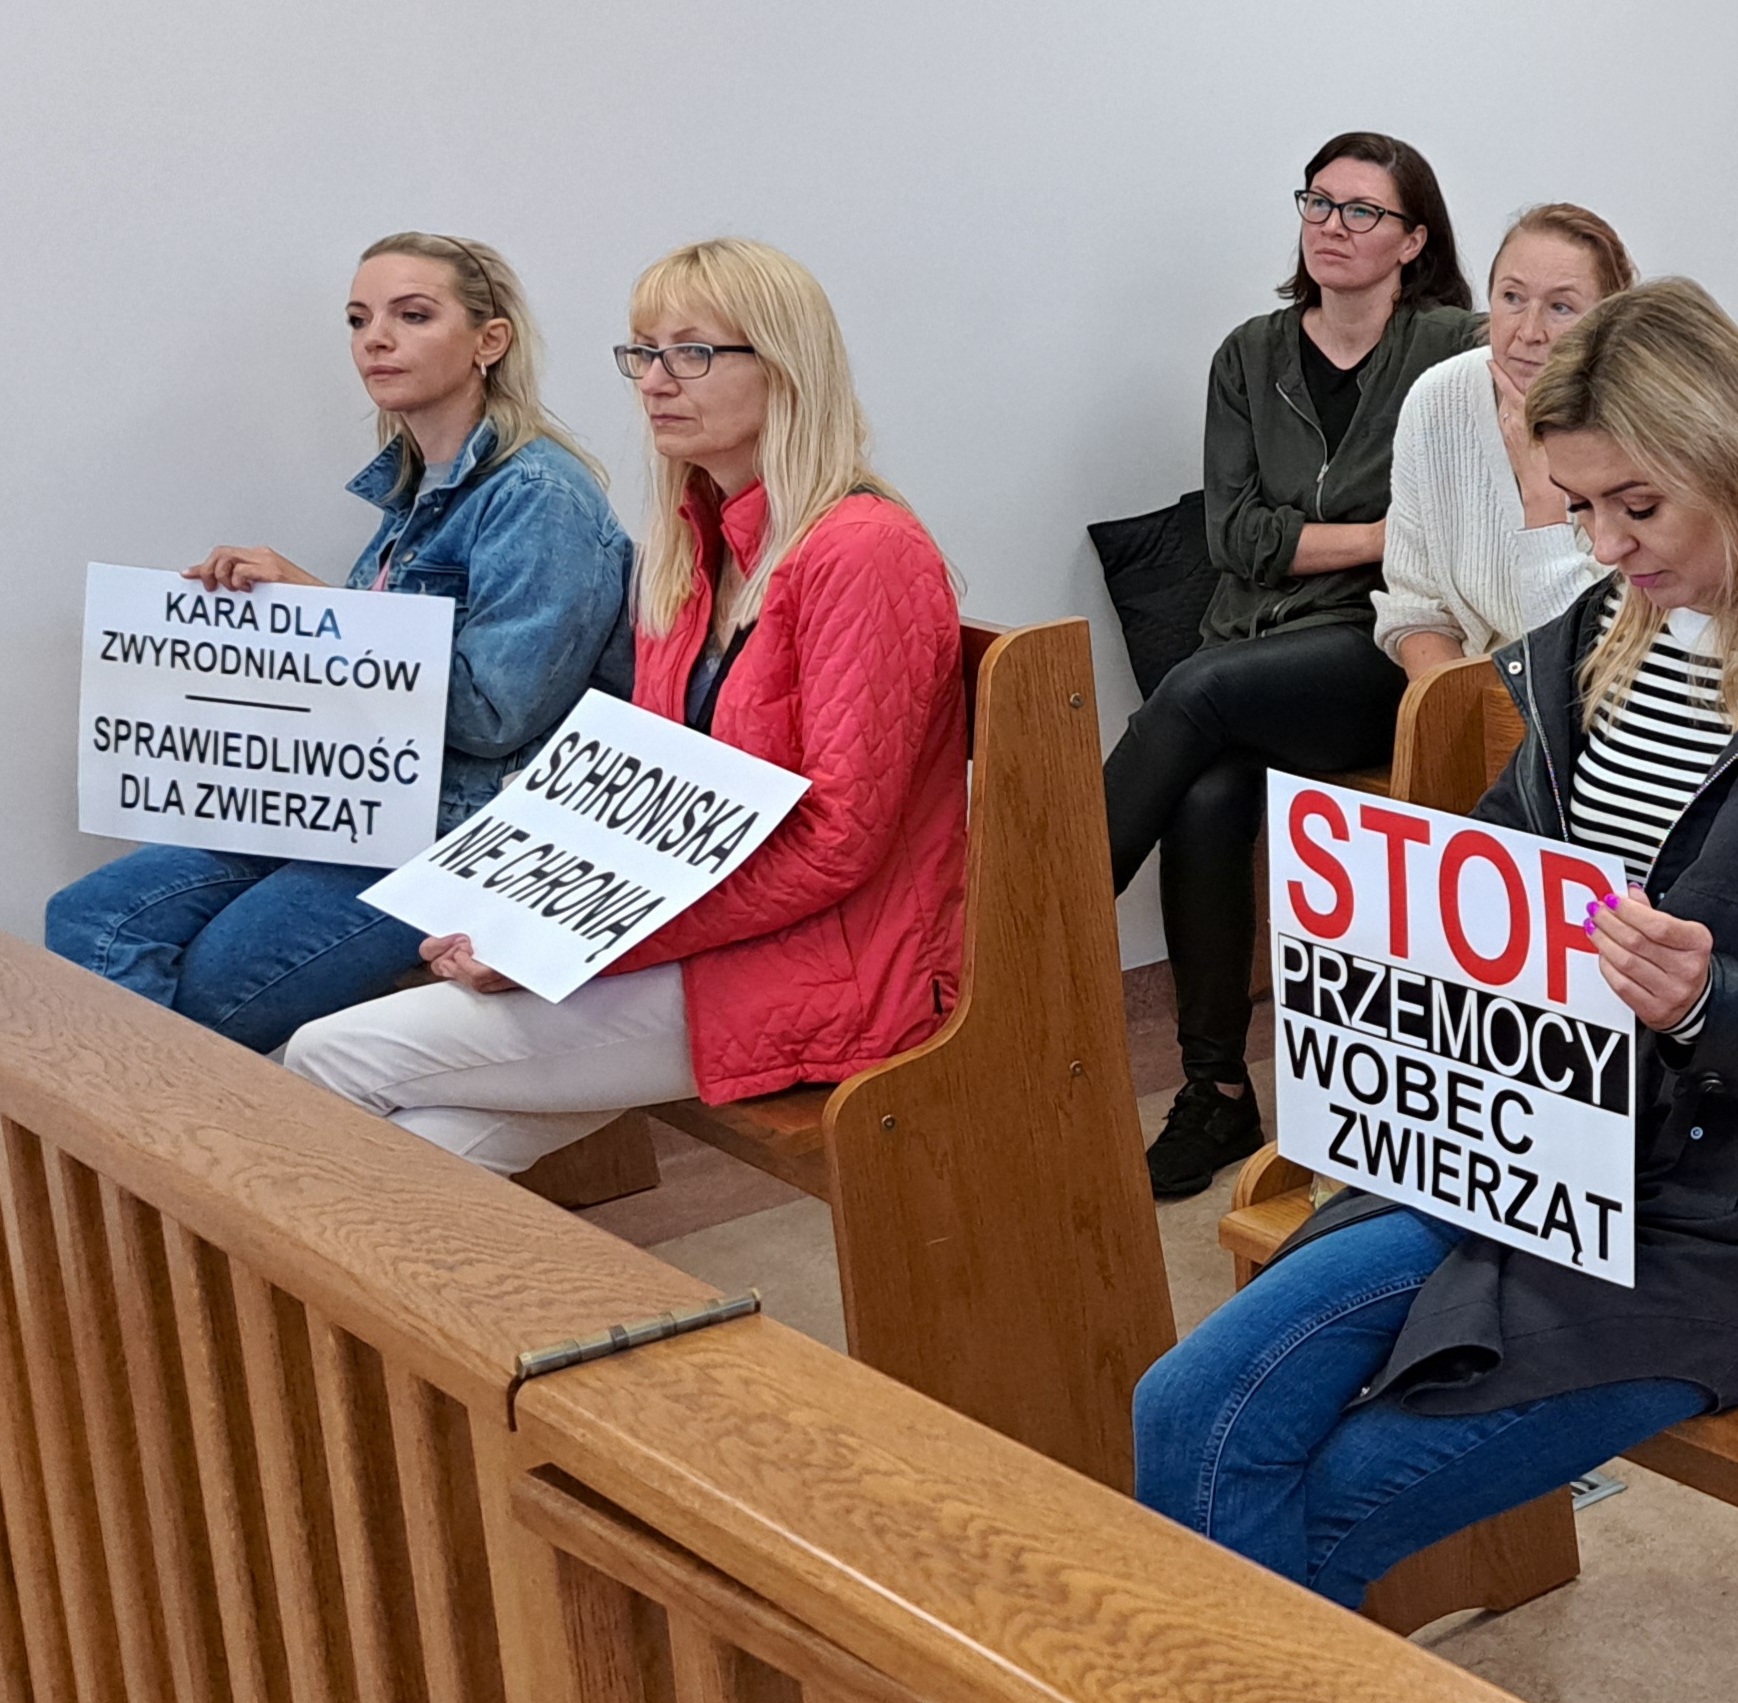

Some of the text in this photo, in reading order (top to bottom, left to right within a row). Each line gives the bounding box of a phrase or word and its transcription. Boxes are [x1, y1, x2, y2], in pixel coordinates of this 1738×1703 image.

[101, 630, 421, 692] ZWYRODNIALCÓW
[166, 591, 342, 640] KARA DLA
[93, 716, 421, 785] SPRAWIEDLIWOŚĆ
[121, 774, 382, 843] DLA ZWIERZĄT
[525, 731, 760, 875] SCHRONISKA
[429, 816, 666, 964] NIE CHRONIĄ
[1286, 789, 1616, 1005] STOP
[1280, 934, 1622, 1106] PRZEMOCY
[1283, 1018, 1535, 1155] WOBEC
[1328, 1102, 1623, 1267] ZWIERZĄT
